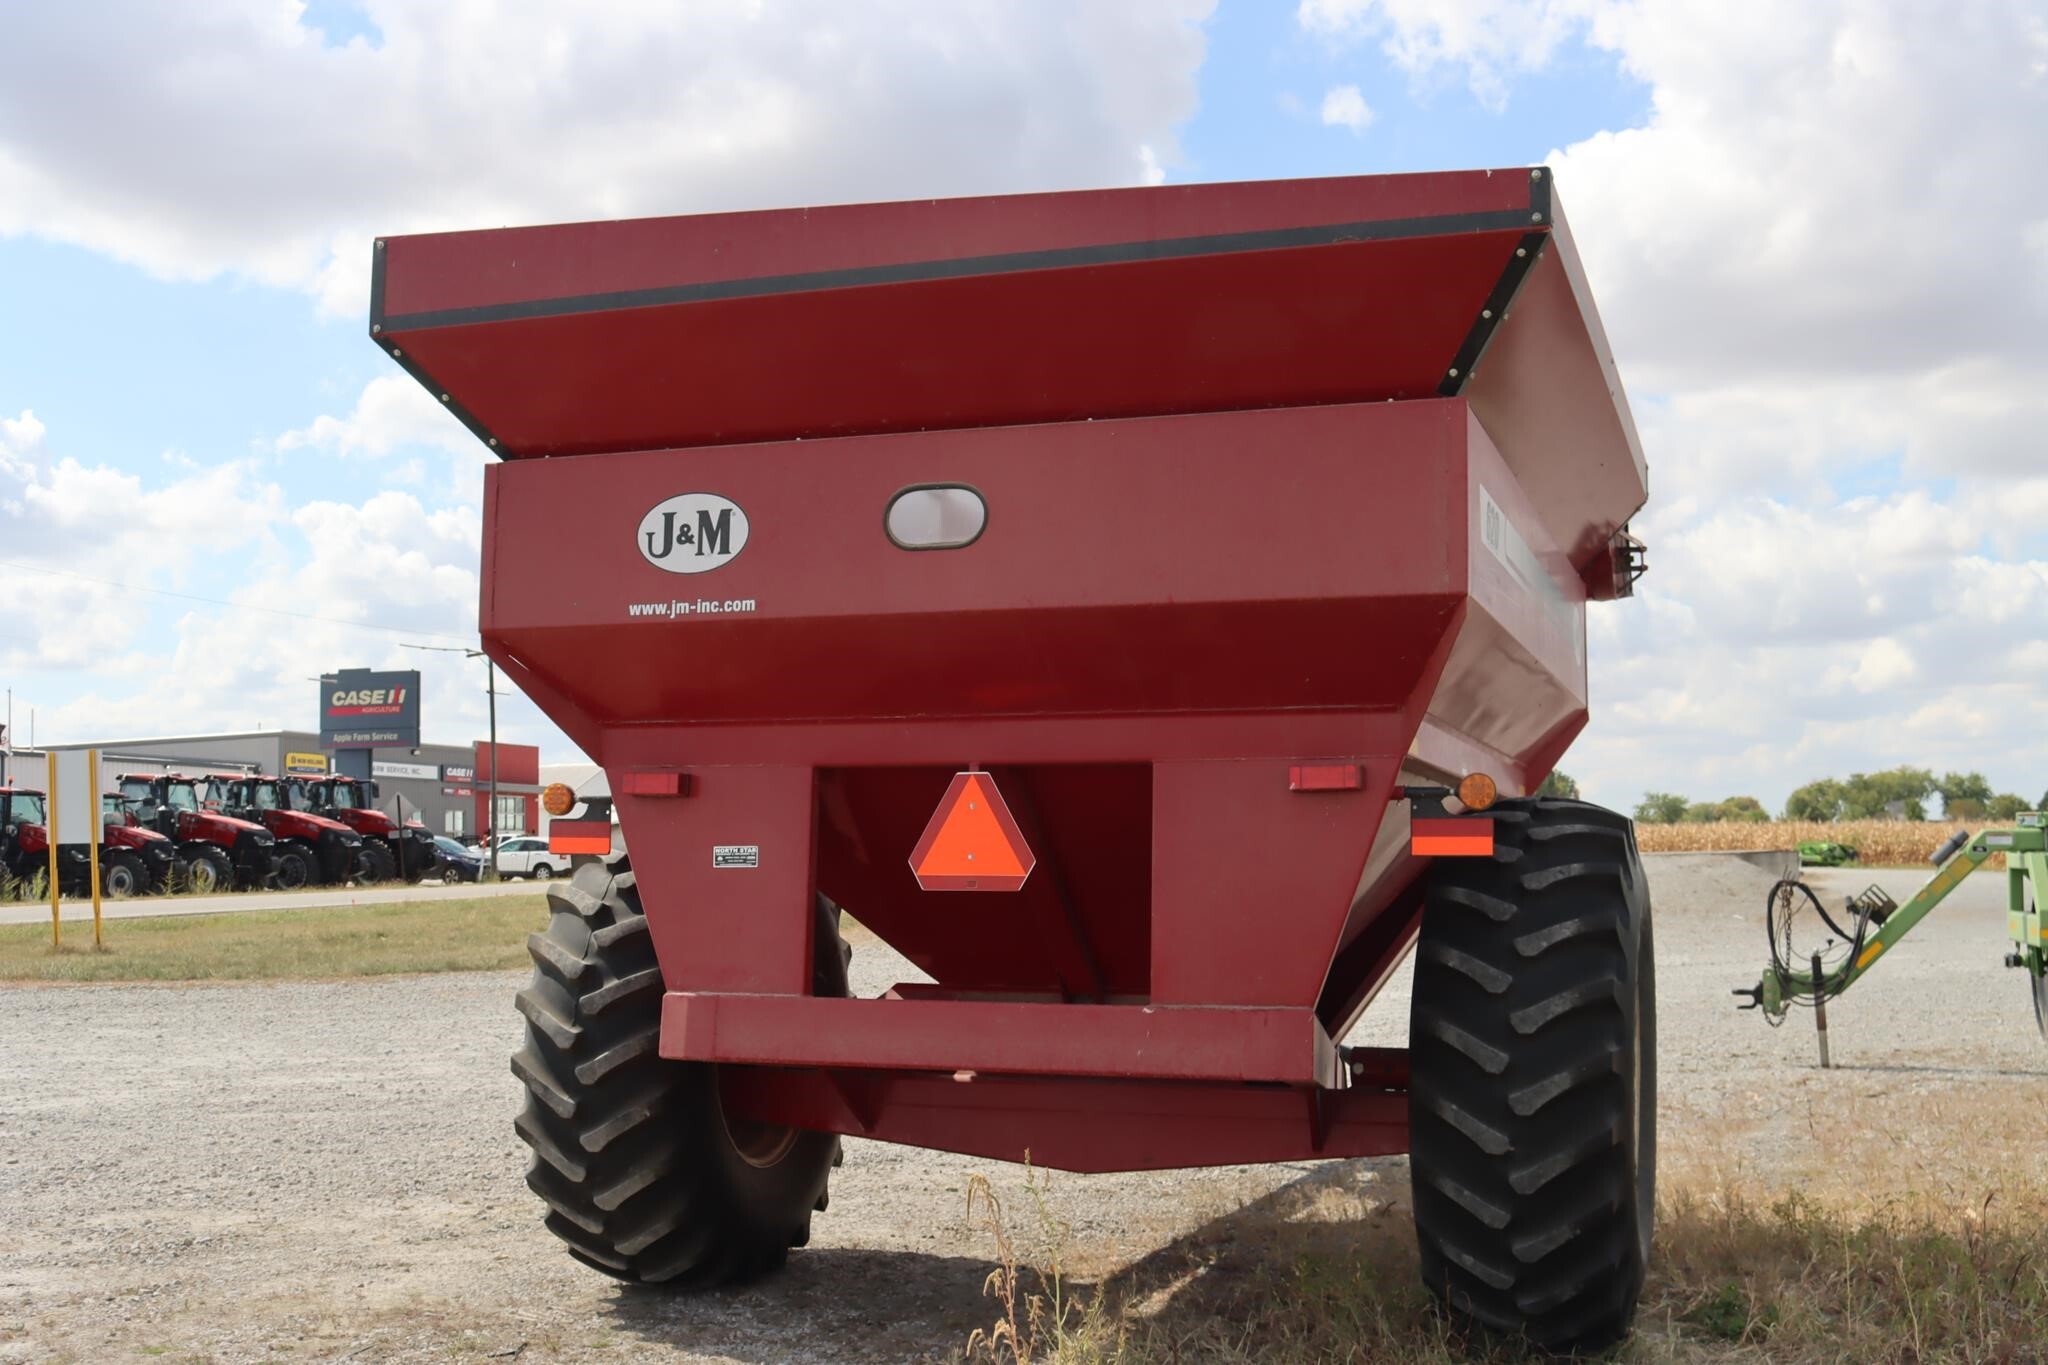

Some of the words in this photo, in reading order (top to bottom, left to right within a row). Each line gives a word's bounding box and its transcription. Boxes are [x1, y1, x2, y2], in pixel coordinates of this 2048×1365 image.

[646, 508, 733, 559] J&M
[629, 599, 756, 619] www.jm-inc.com
[332, 690, 386, 705] CASE
[333, 734, 352, 743] Apple
[353, 733, 370, 741] Farm
[372, 732, 398, 741] Service
[446, 767, 466, 777] CASE
